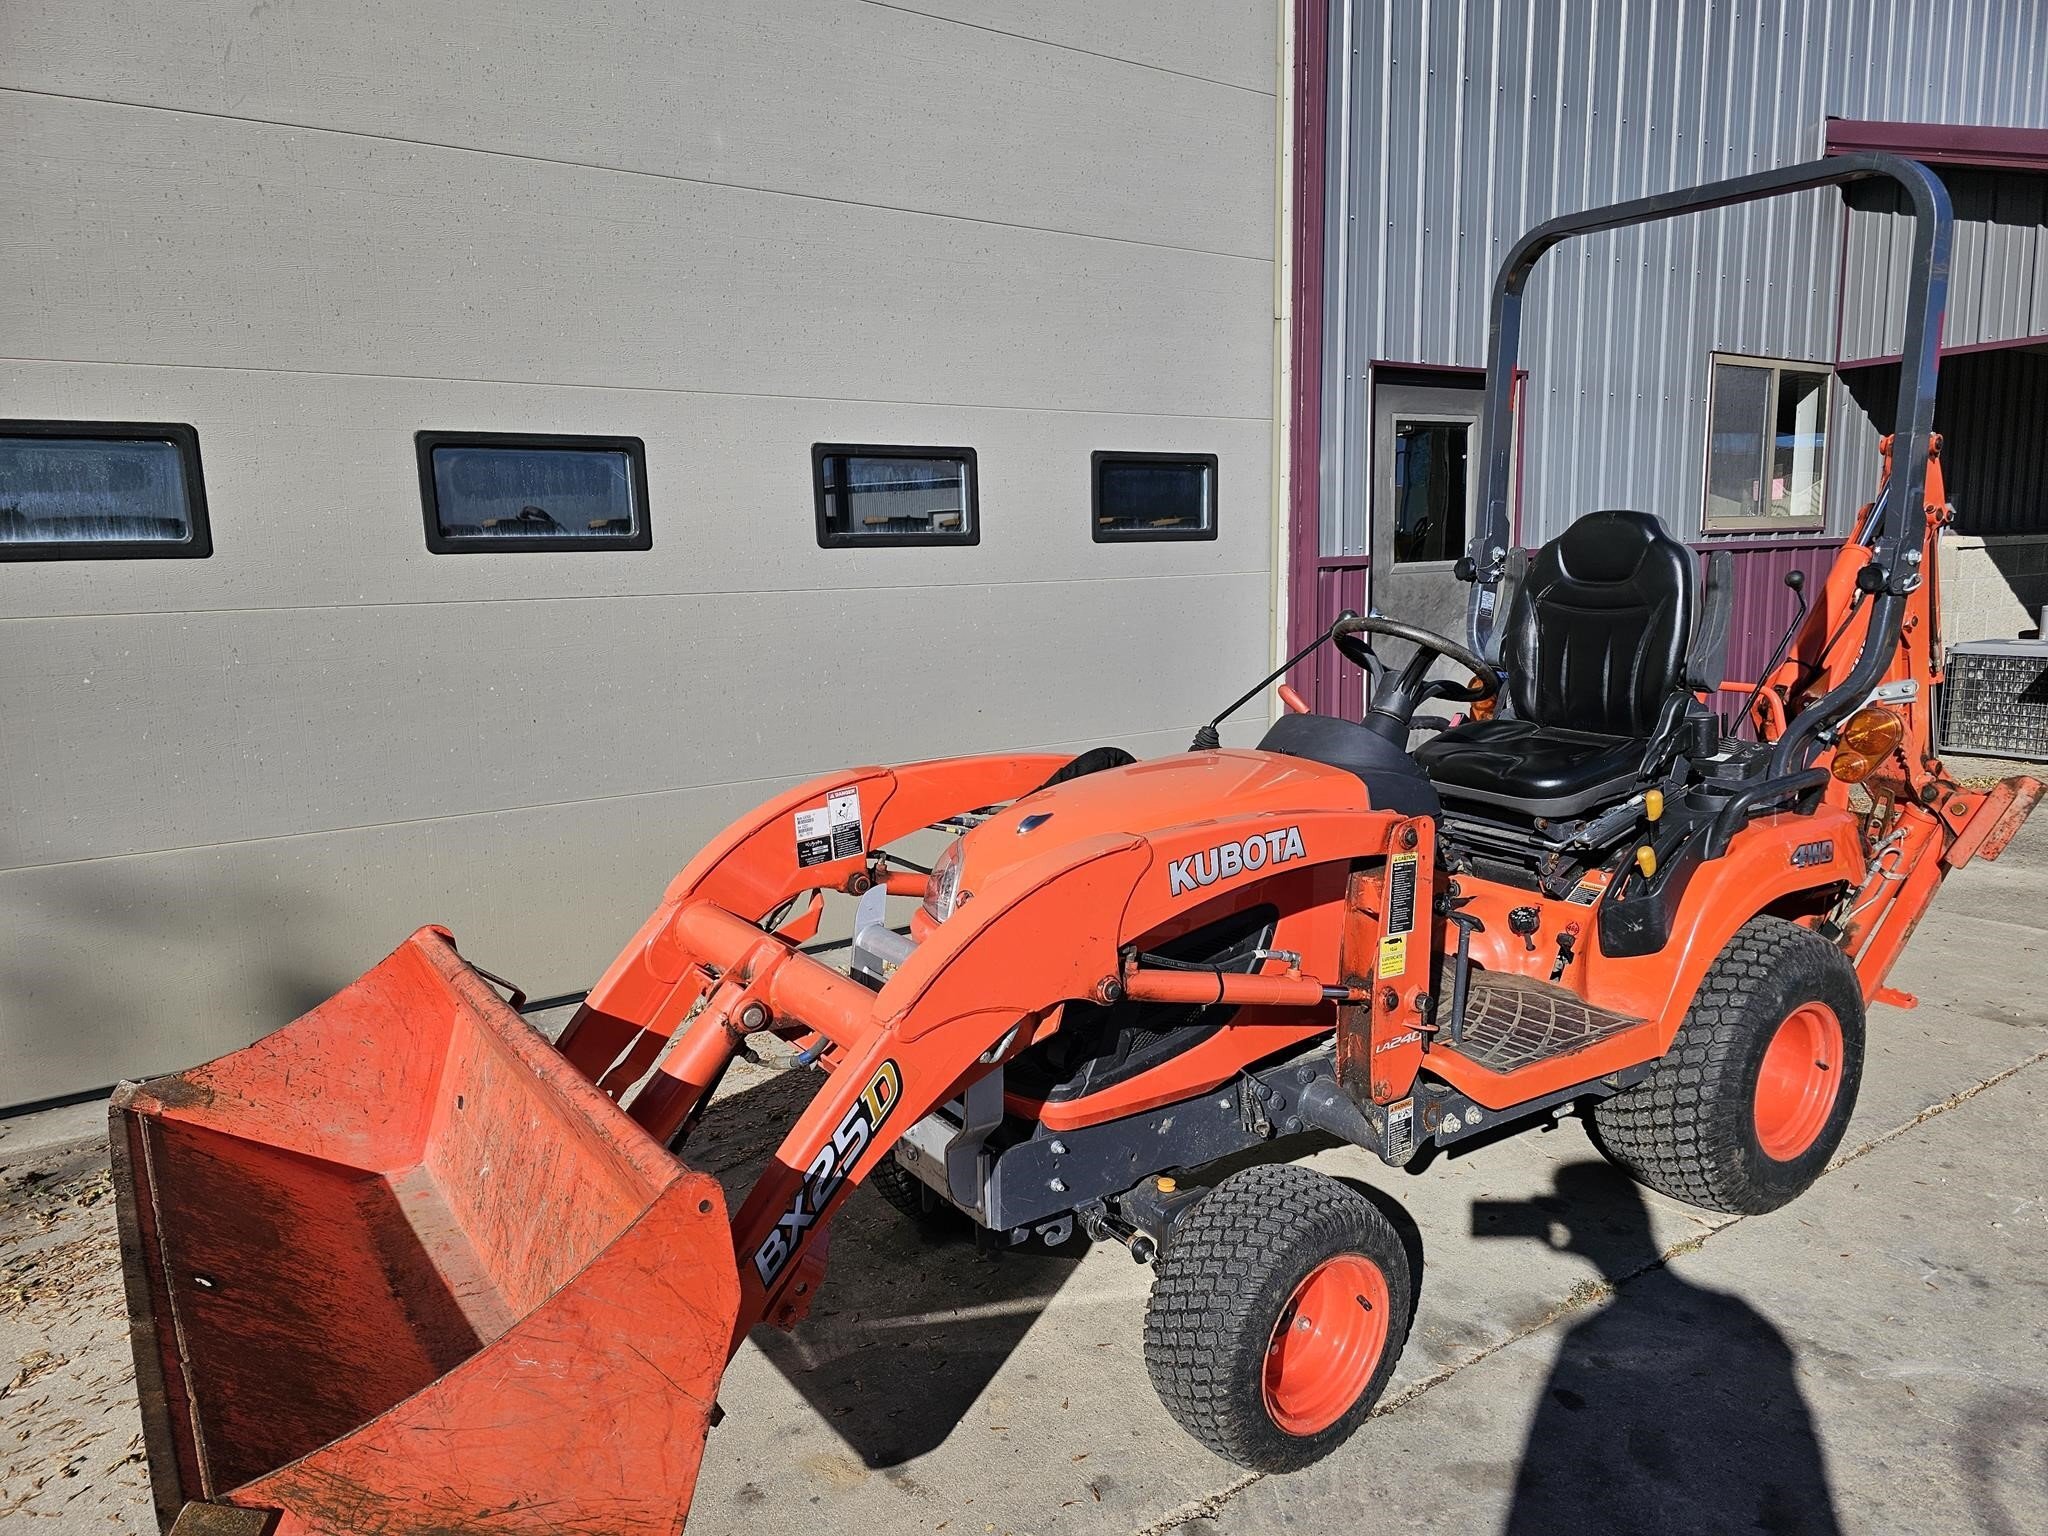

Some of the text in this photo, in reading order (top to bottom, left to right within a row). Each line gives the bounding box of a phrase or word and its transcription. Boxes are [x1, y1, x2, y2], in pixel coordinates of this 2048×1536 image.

[1169, 826, 1306, 897] KUBOTA
[1791, 840, 1833, 868] 4WD
[1375, 1031, 1421, 1054] LA240
[754, 1059, 902, 1290] BX25D
